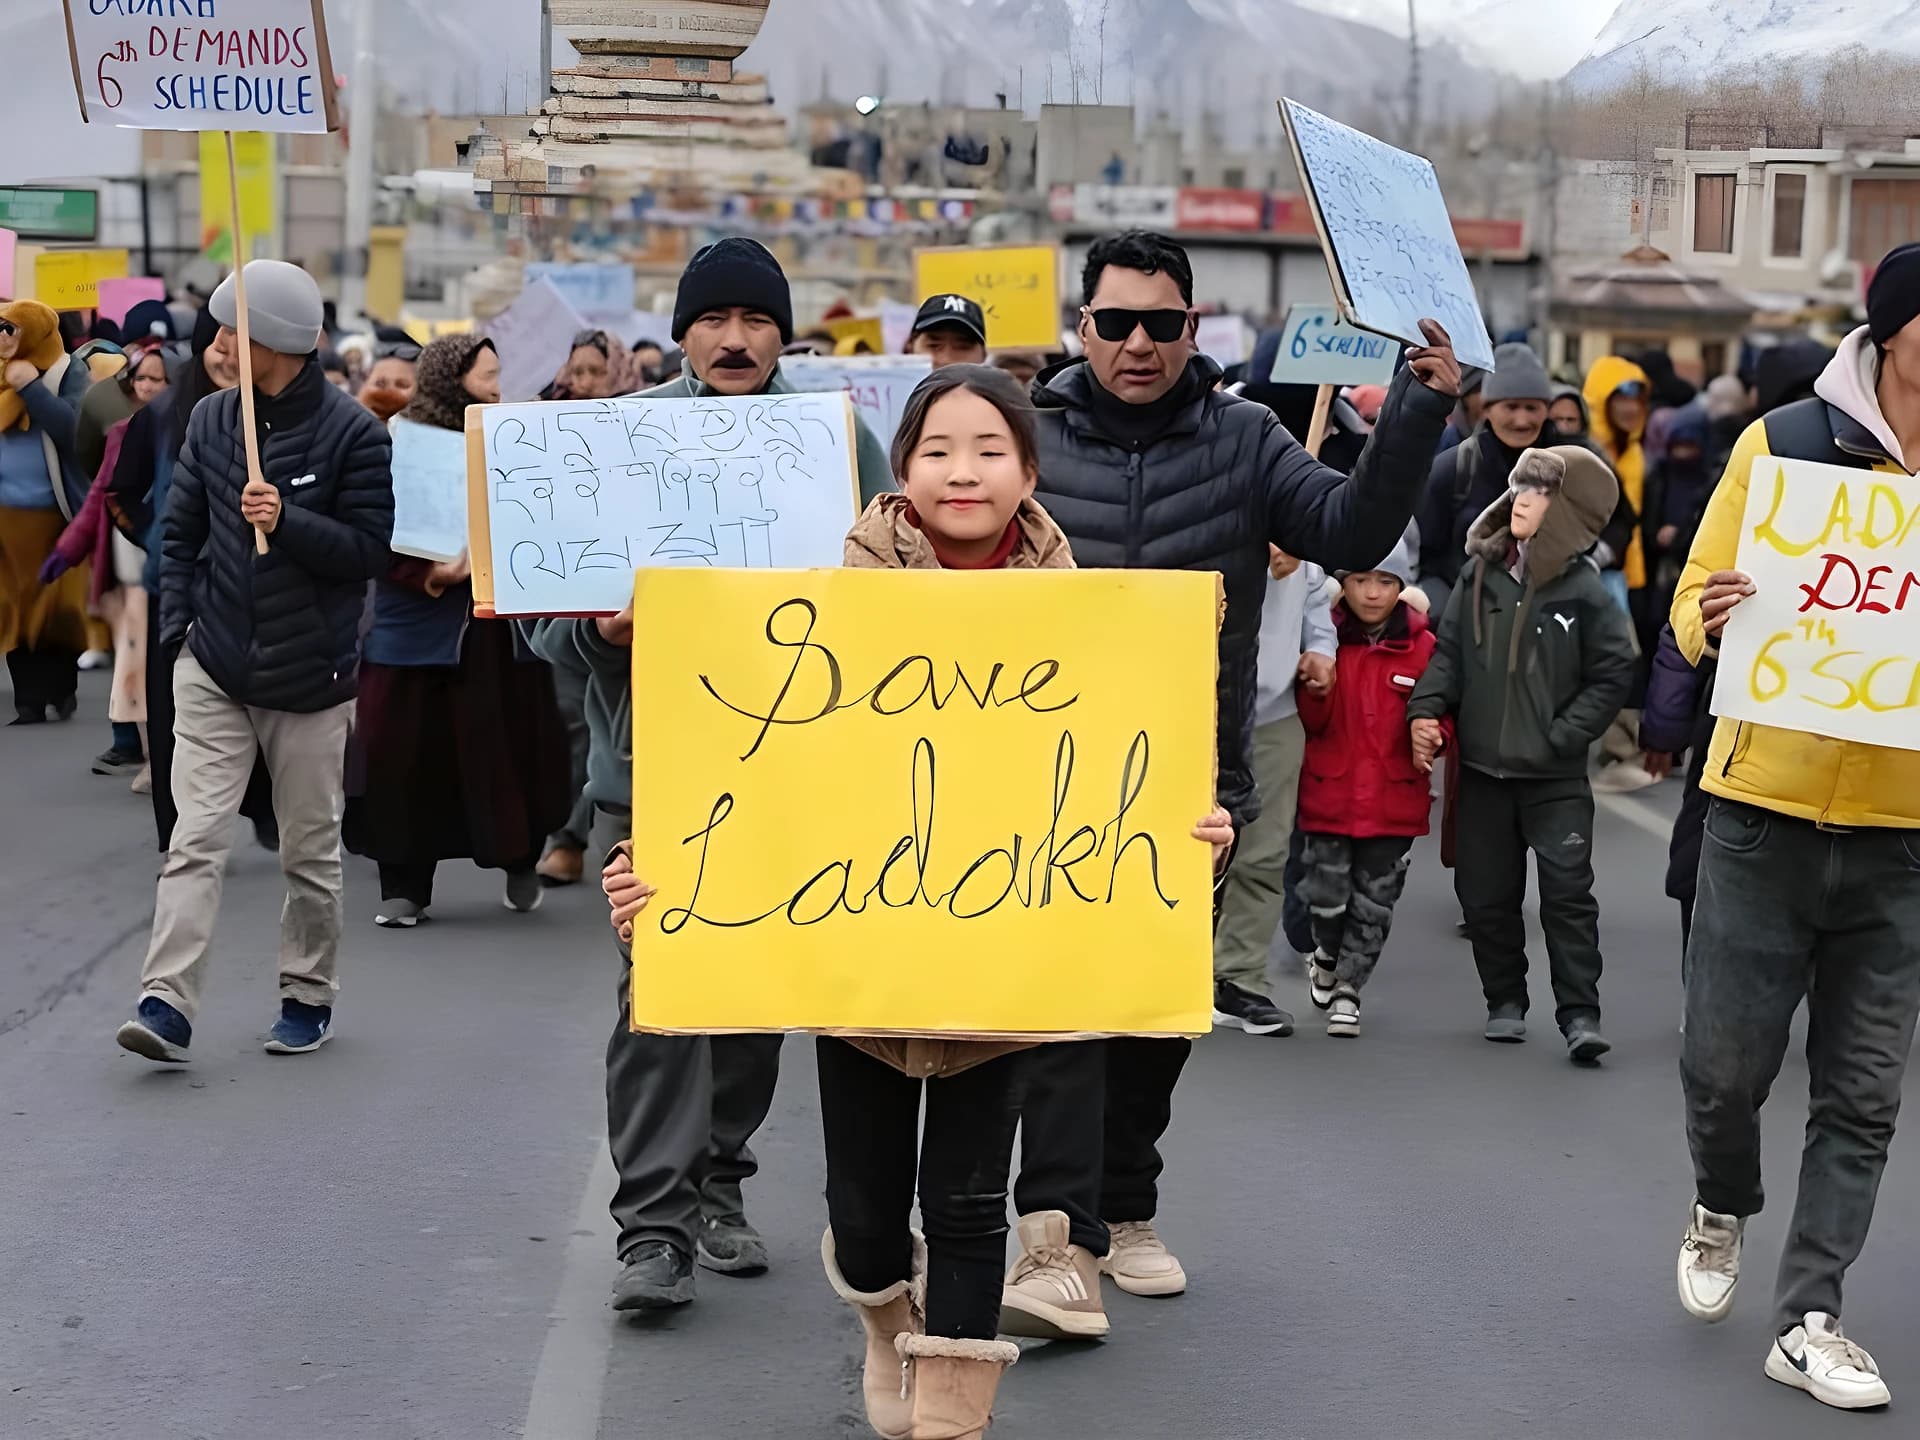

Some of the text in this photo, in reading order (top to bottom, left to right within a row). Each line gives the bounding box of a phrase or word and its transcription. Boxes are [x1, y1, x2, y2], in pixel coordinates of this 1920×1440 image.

[148, 25, 309, 69] DEMANDS
[153, 74, 314, 116] SCHEDULE
[697, 597, 1080, 762] Save
[660, 729, 1179, 935] Ladakh
